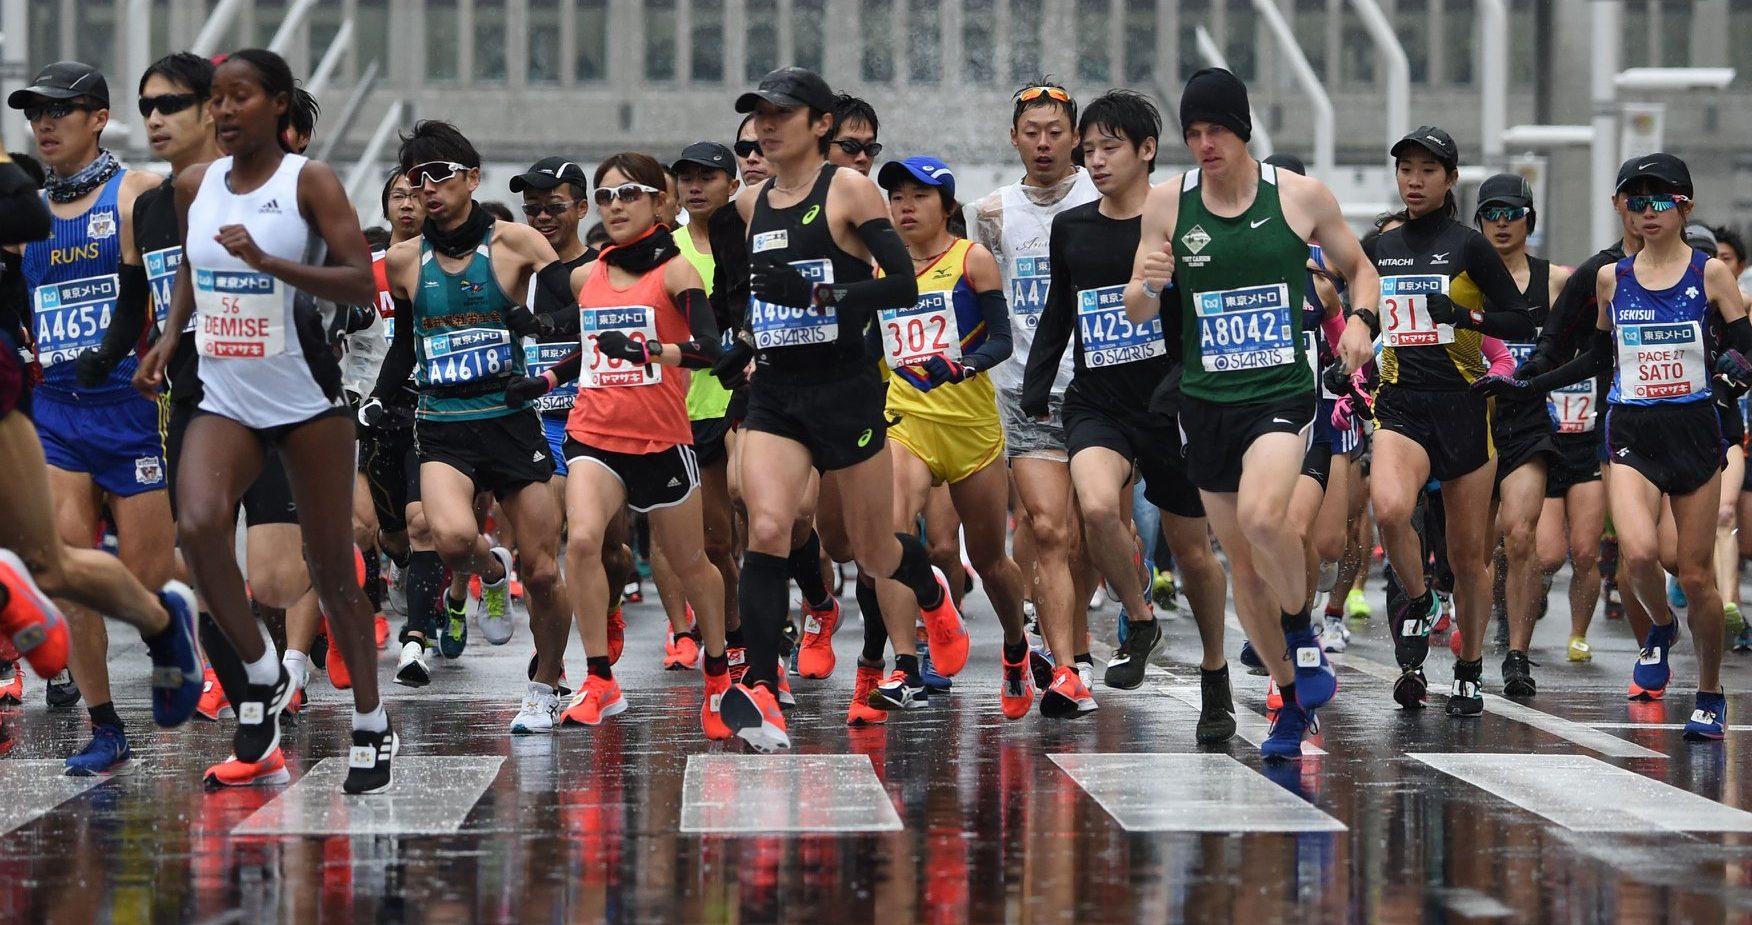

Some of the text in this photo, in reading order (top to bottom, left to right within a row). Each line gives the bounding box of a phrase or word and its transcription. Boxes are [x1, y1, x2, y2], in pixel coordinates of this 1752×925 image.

[51, 242, 99, 265] RUNS
[1378, 258, 1414, 266] HITACHI
[62, 282, 112, 300] 東京メトロ
[215, 279, 270, 289] 東京メトロ
[1398, 281, 1439, 291] 東京メトロ
[221, 297, 240, 314] 56
[1225, 291, 1278, 307] 東京メトロ
[599, 313, 643, 325] 東京メトロ
[1385, 298, 1438, 331] 31
[1619, 309, 1655, 320] SEKISUI
[38, 303, 112, 344] A4654
[204, 315, 270, 337] DEMISE
[1201, 311, 1279, 348] A8042
[452, 332, 499, 347] 東京メトロ
[887, 314, 950, 357] 302
[1400, 334, 1437, 344] ヤマザキ
[1643, 328, 1692, 341] 東京メトロ
[1638, 349, 1685, 362] PACE 27
[430, 348, 501, 385] A4618
[1638, 362, 1684, 381] SATO
[601, 373, 641, 384] ヤマザキ
[1648, 384, 1689, 397] ヤマザキ
